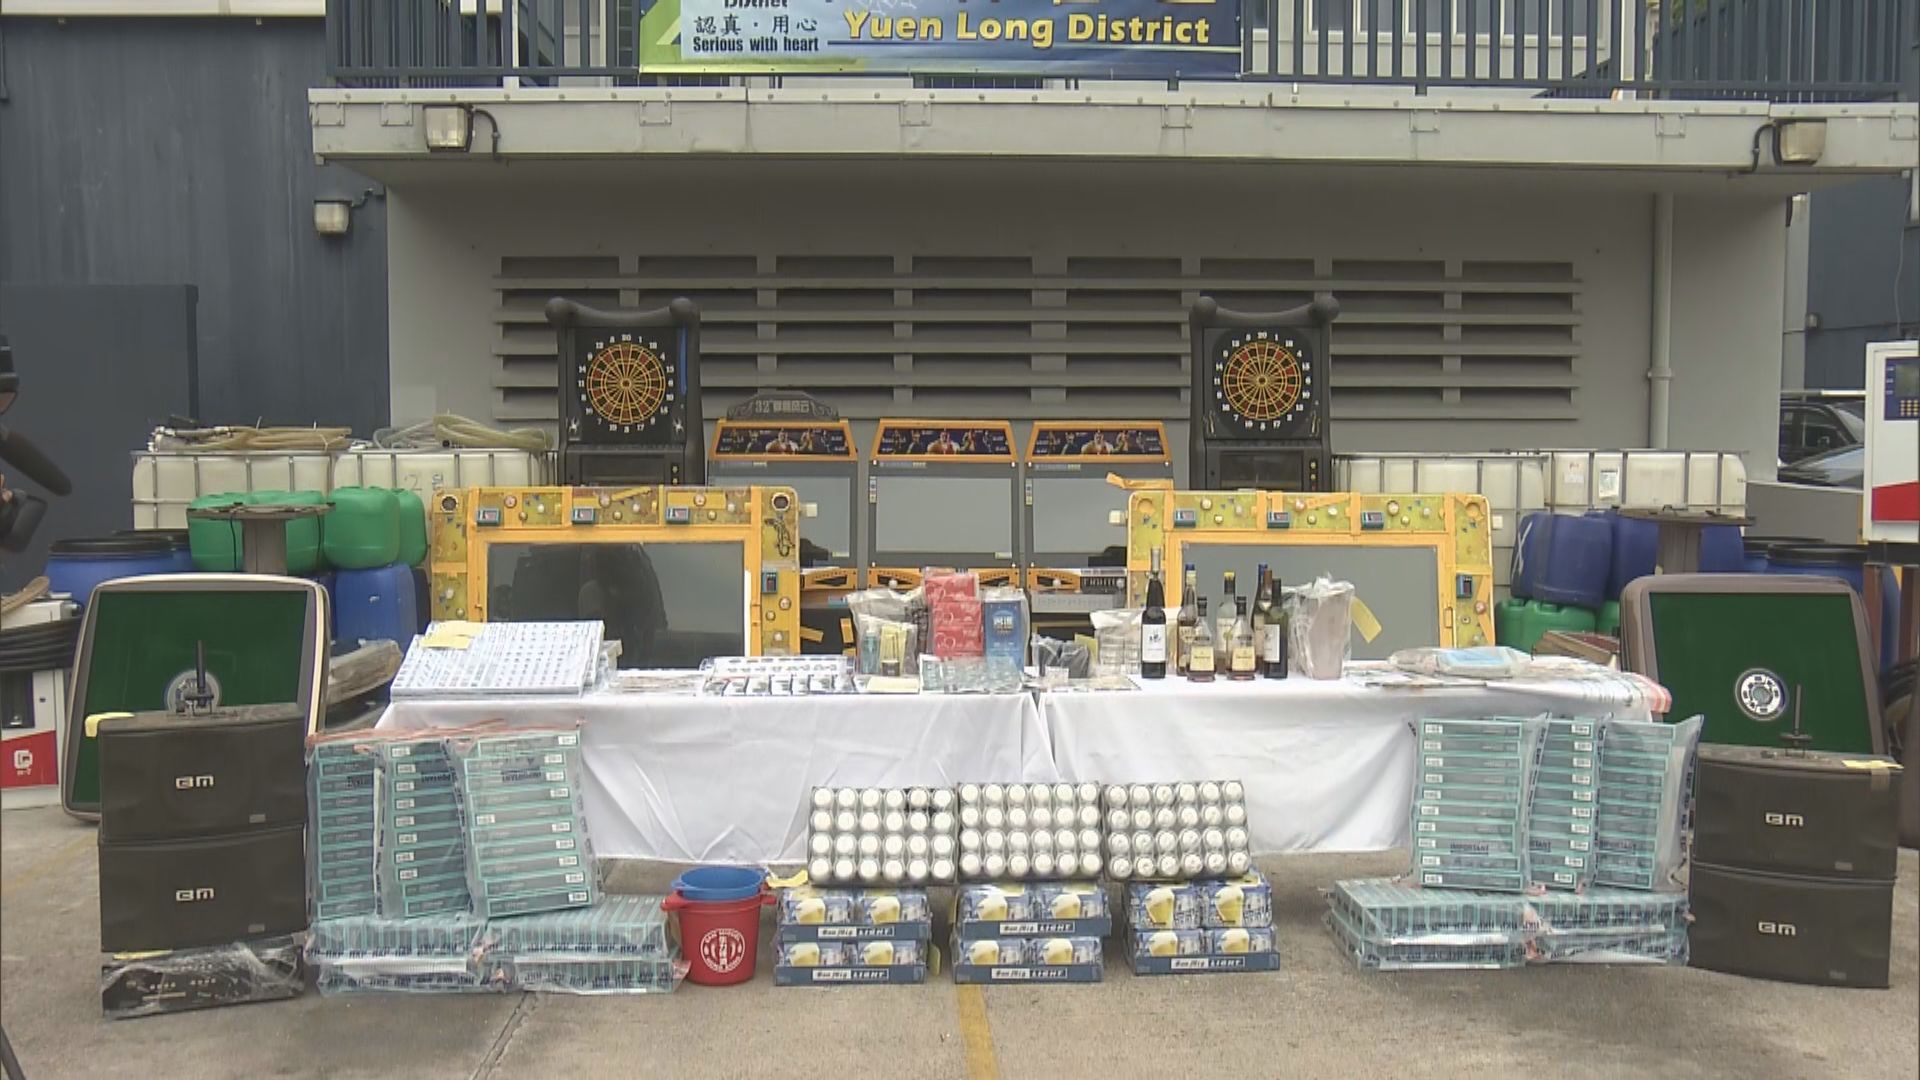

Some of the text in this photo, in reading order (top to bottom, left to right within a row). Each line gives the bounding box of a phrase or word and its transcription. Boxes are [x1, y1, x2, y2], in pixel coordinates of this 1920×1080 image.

[844, 10, 1210, 48] Yuen Long District
[693, 36, 819, 52] Serious with heart
